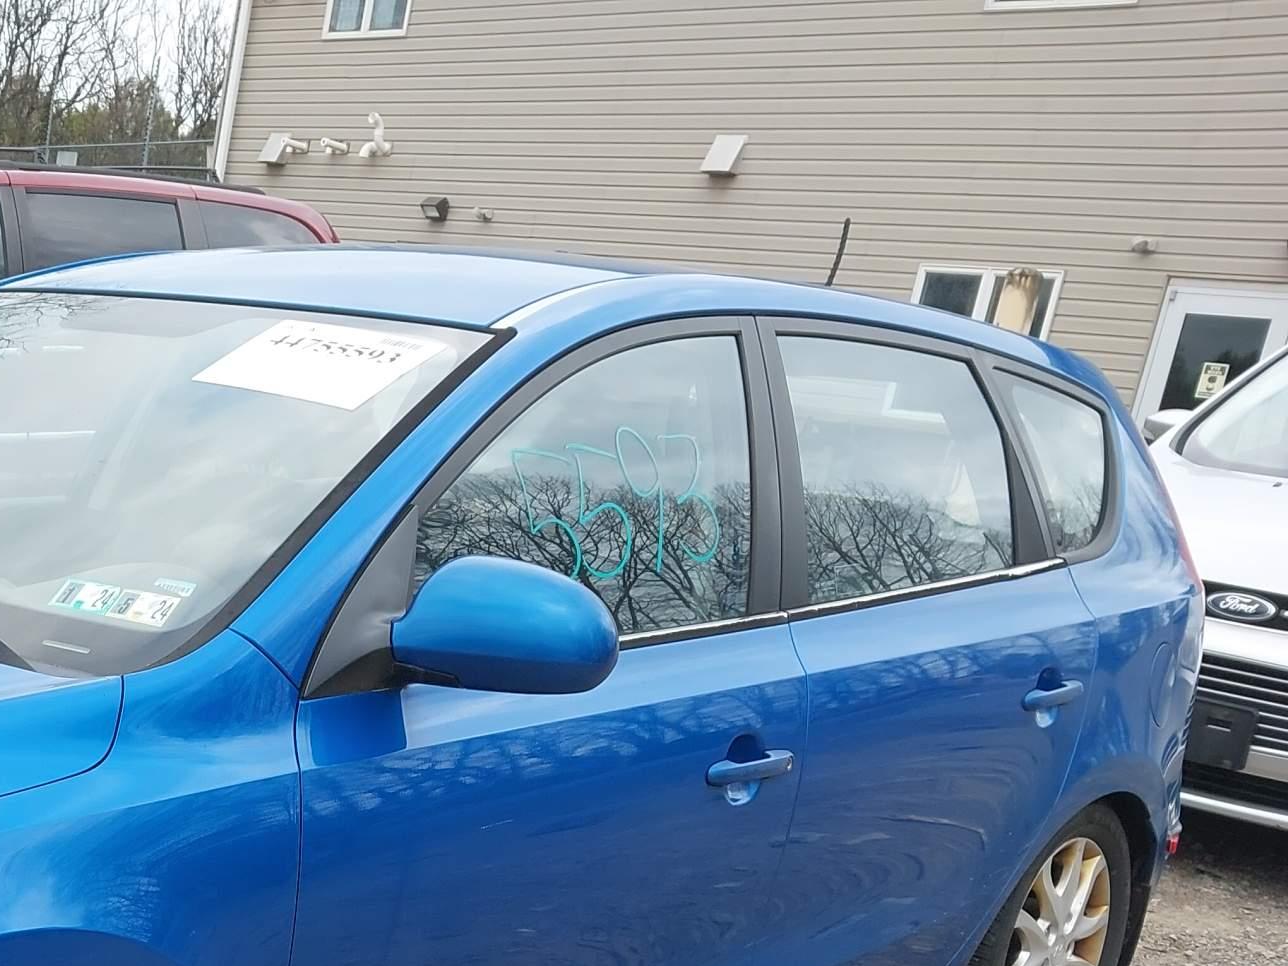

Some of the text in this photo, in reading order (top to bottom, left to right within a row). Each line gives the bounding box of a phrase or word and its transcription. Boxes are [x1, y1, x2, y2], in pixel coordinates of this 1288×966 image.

[269, 334, 402, 364] 44755593
[511, 426, 720, 581] 5593
[91, 588, 114, 609] 24
[118, 597, 174, 621] 5 24
[1219, 595, 1259, 614] Ford
